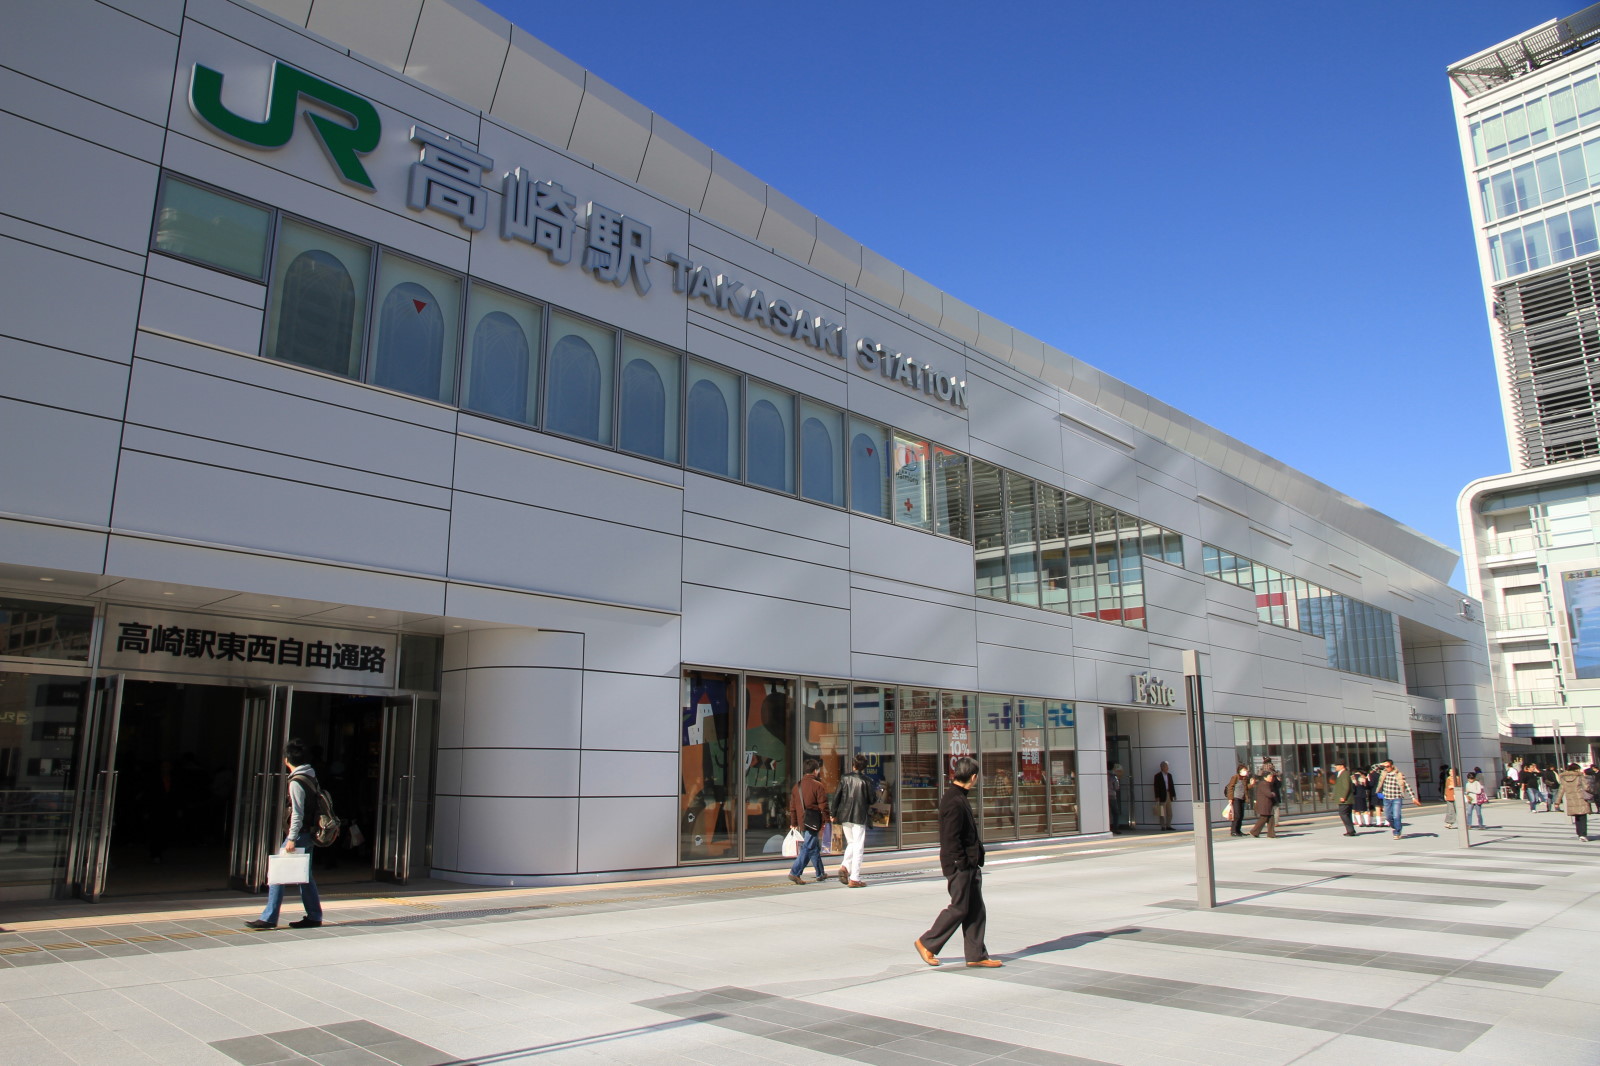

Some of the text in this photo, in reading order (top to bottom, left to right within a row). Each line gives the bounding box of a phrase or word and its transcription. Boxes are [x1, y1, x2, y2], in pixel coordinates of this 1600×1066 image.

[188, 60, 382, 194] JR
[407, 125, 653, 296] 高崎駅
[666, 253, 968, 410] TAKASAKI STATION
[116, 621, 387, 675] 高崎駅東西自由通路
[949, 740, 970, 756] 10%
[951, 727, 968, 740] 全品
